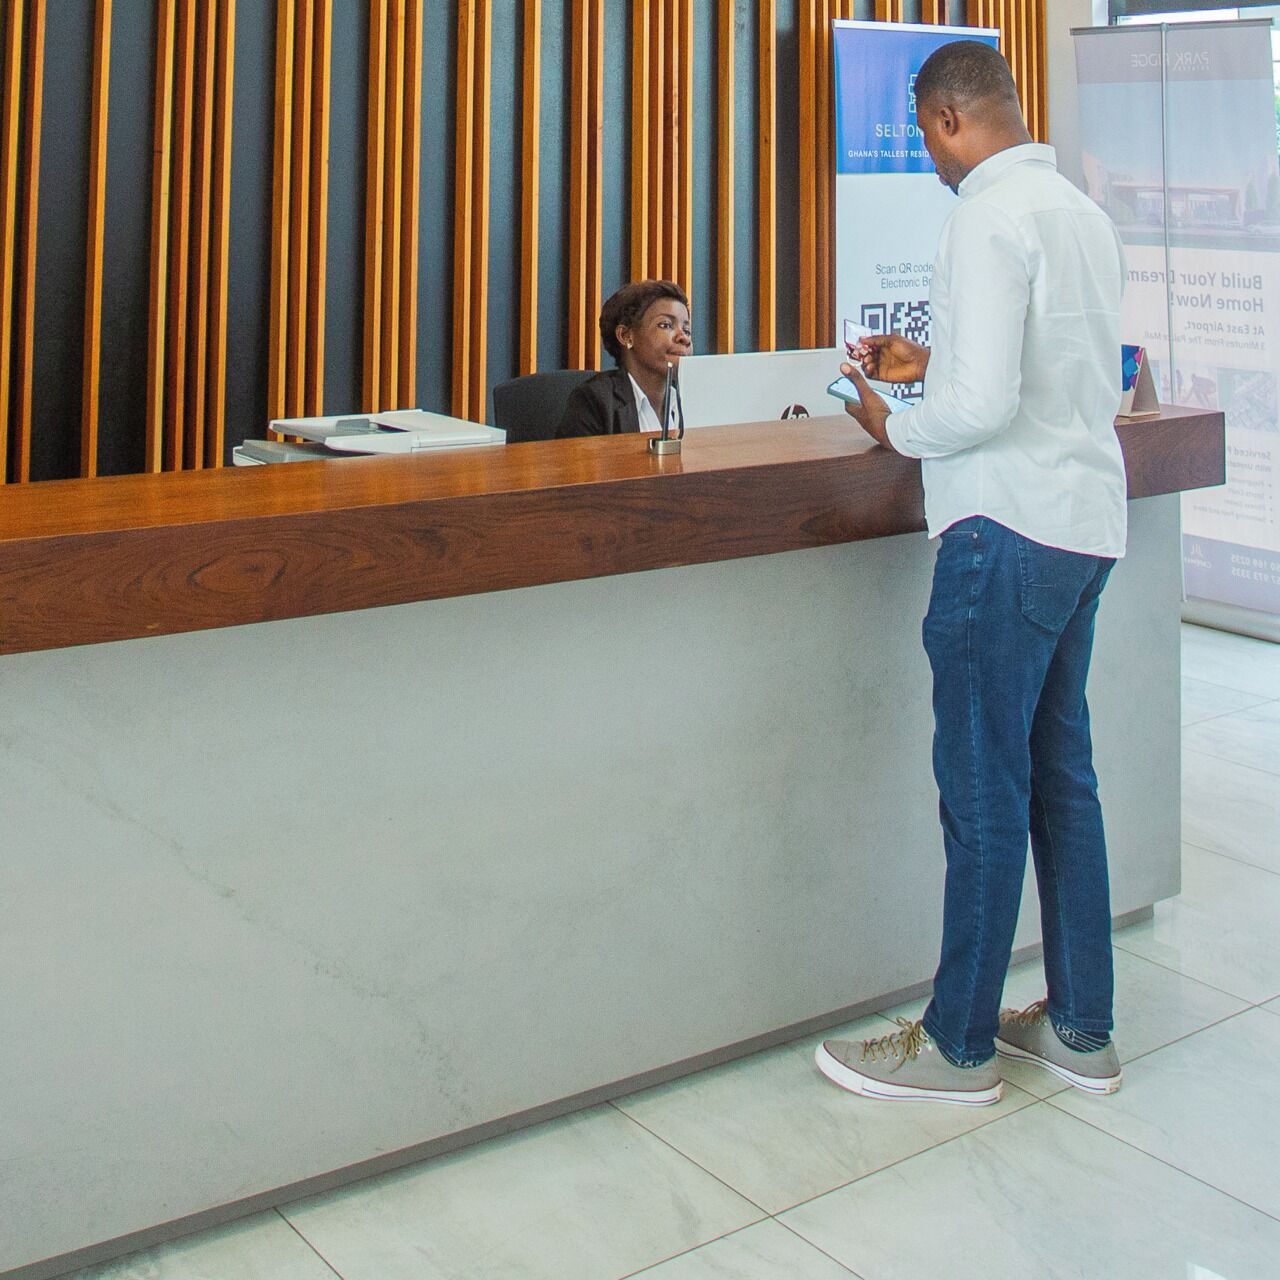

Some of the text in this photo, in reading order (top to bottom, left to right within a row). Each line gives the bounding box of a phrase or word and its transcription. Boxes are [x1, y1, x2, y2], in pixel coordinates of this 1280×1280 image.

[848, 150, 878, 158] GHANA'S
[880, 150, 909, 158] TALLEST
[875, 262, 933, 275] Scan QR code
[881, 277, 920, 288] Electronic
